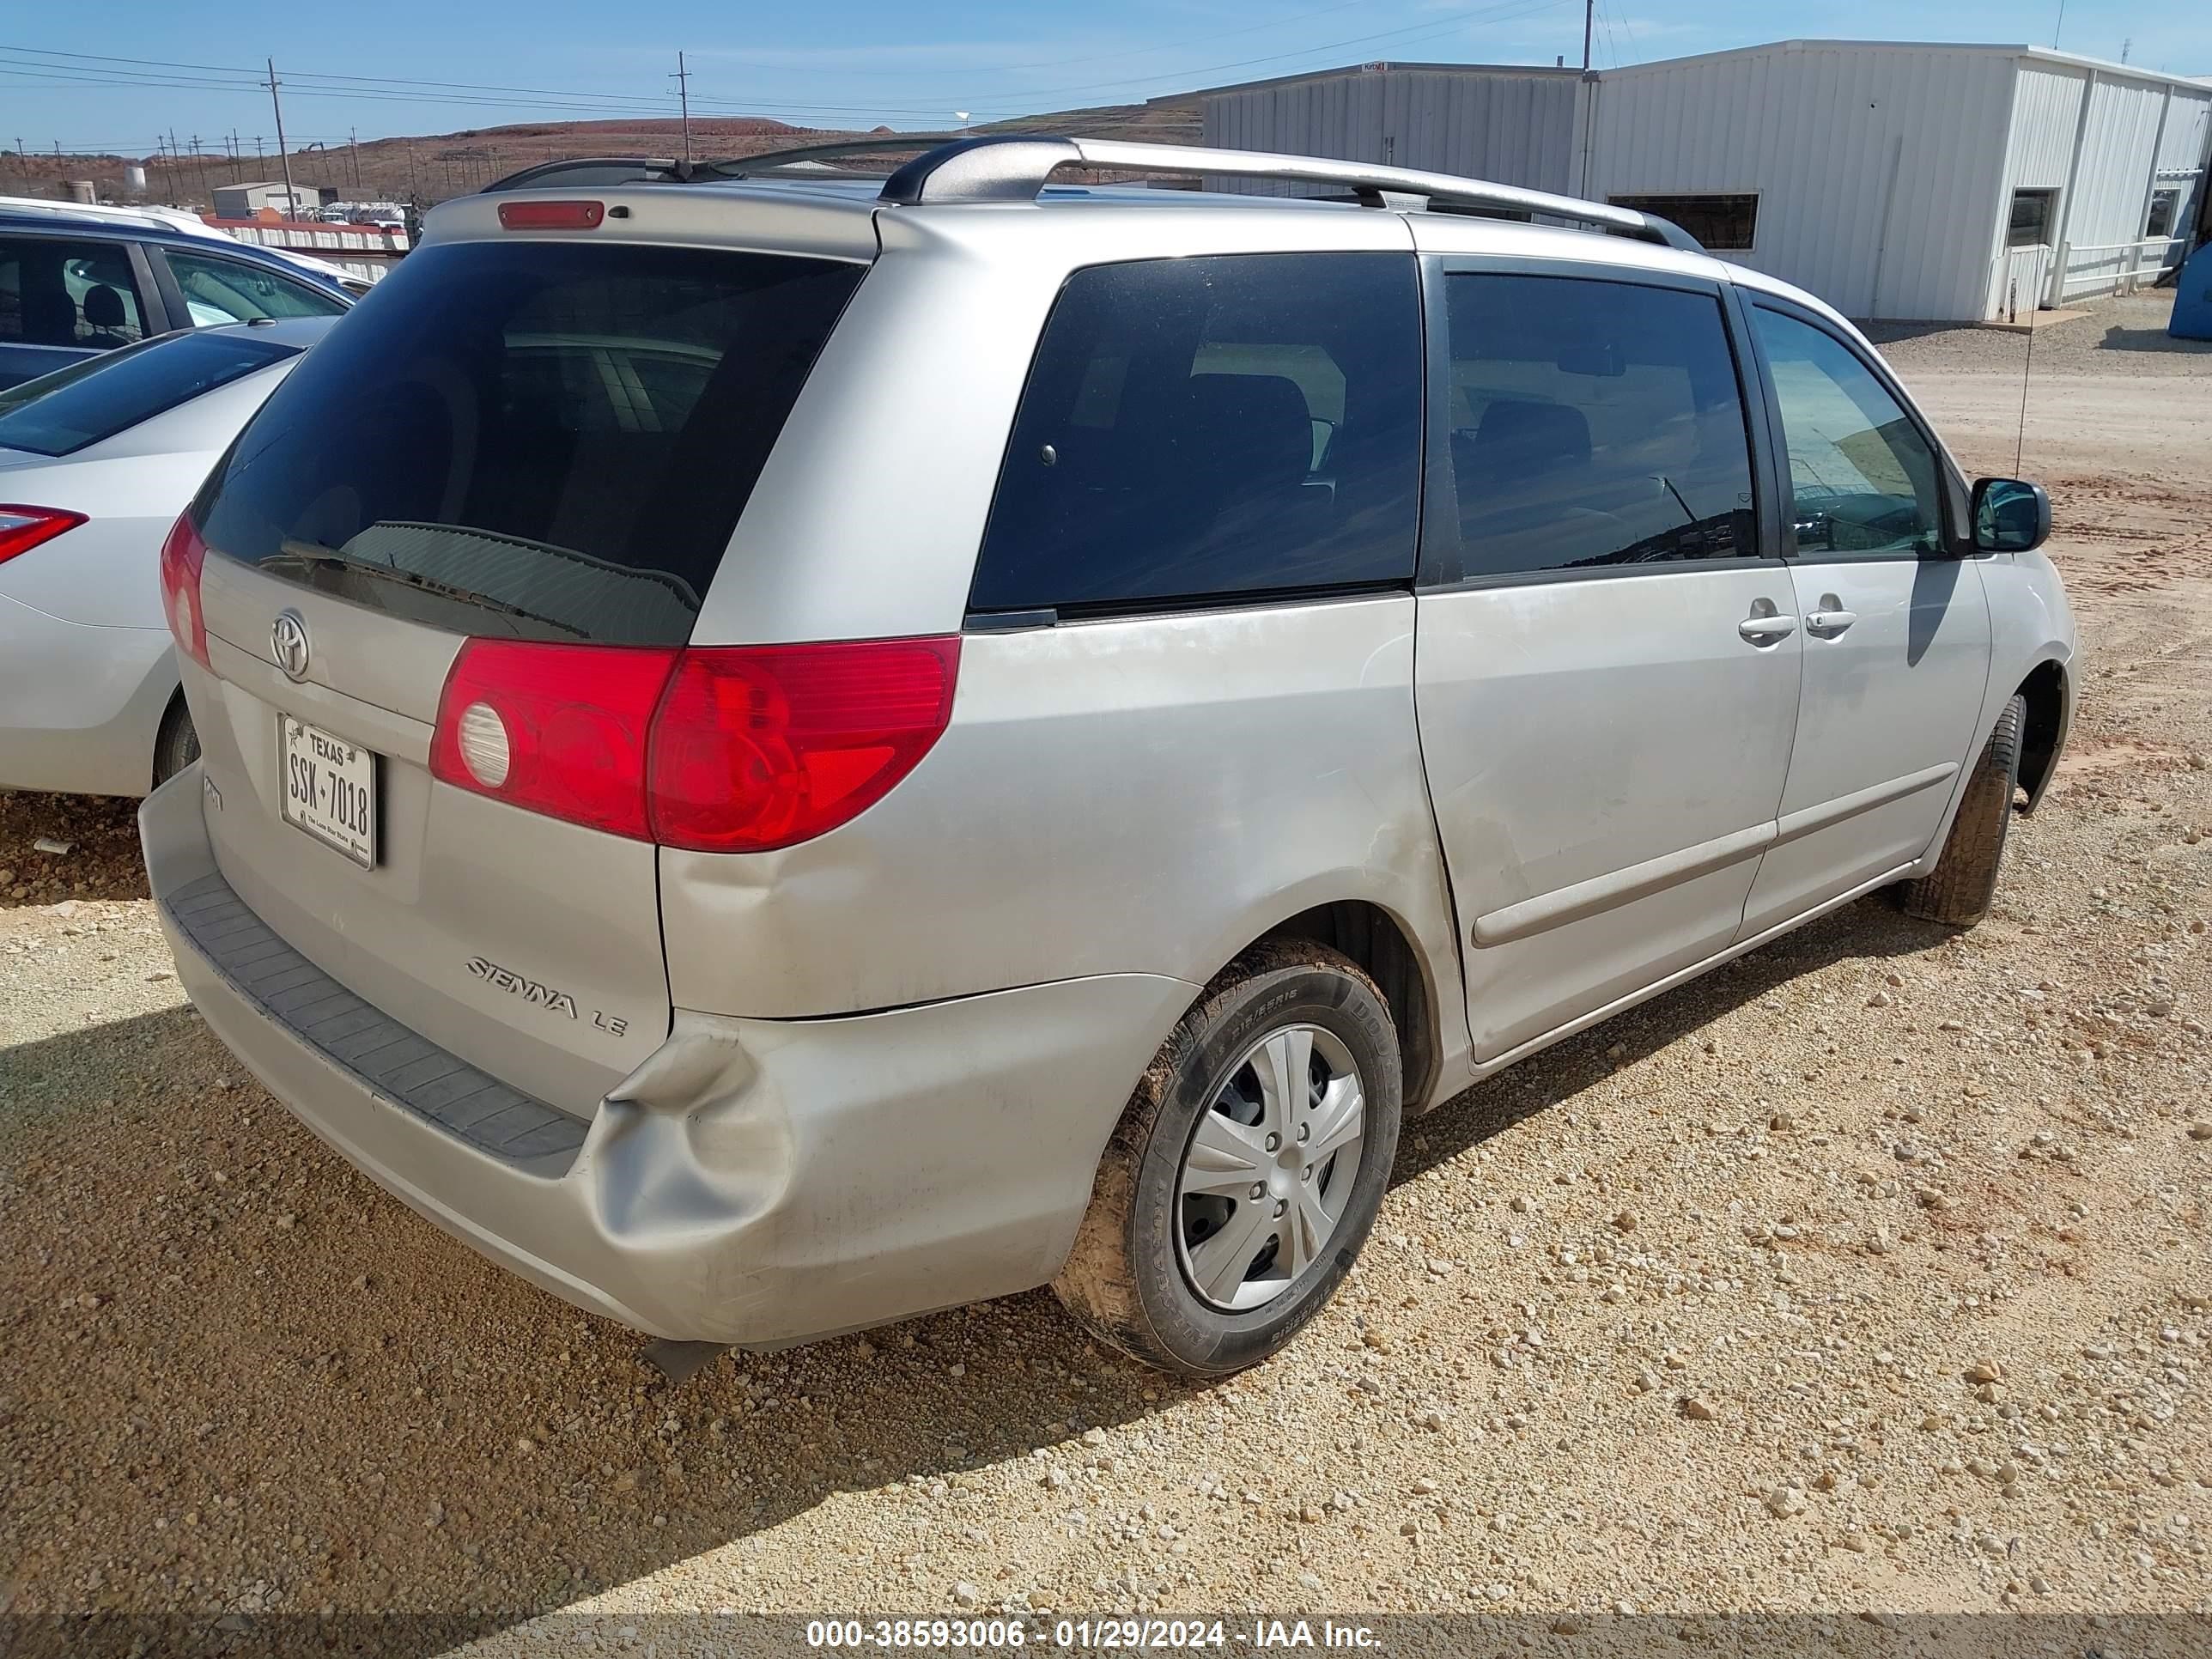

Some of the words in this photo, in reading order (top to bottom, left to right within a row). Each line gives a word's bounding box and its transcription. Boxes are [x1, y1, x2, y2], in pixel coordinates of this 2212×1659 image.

[310, 732, 344, 767] TEXAS
[290, 752, 317, 810] SSK
[328, 770, 368, 836] 7018
[465, 956, 578, 1019] SIENNA
[590, 1010, 629, 1037] LE
